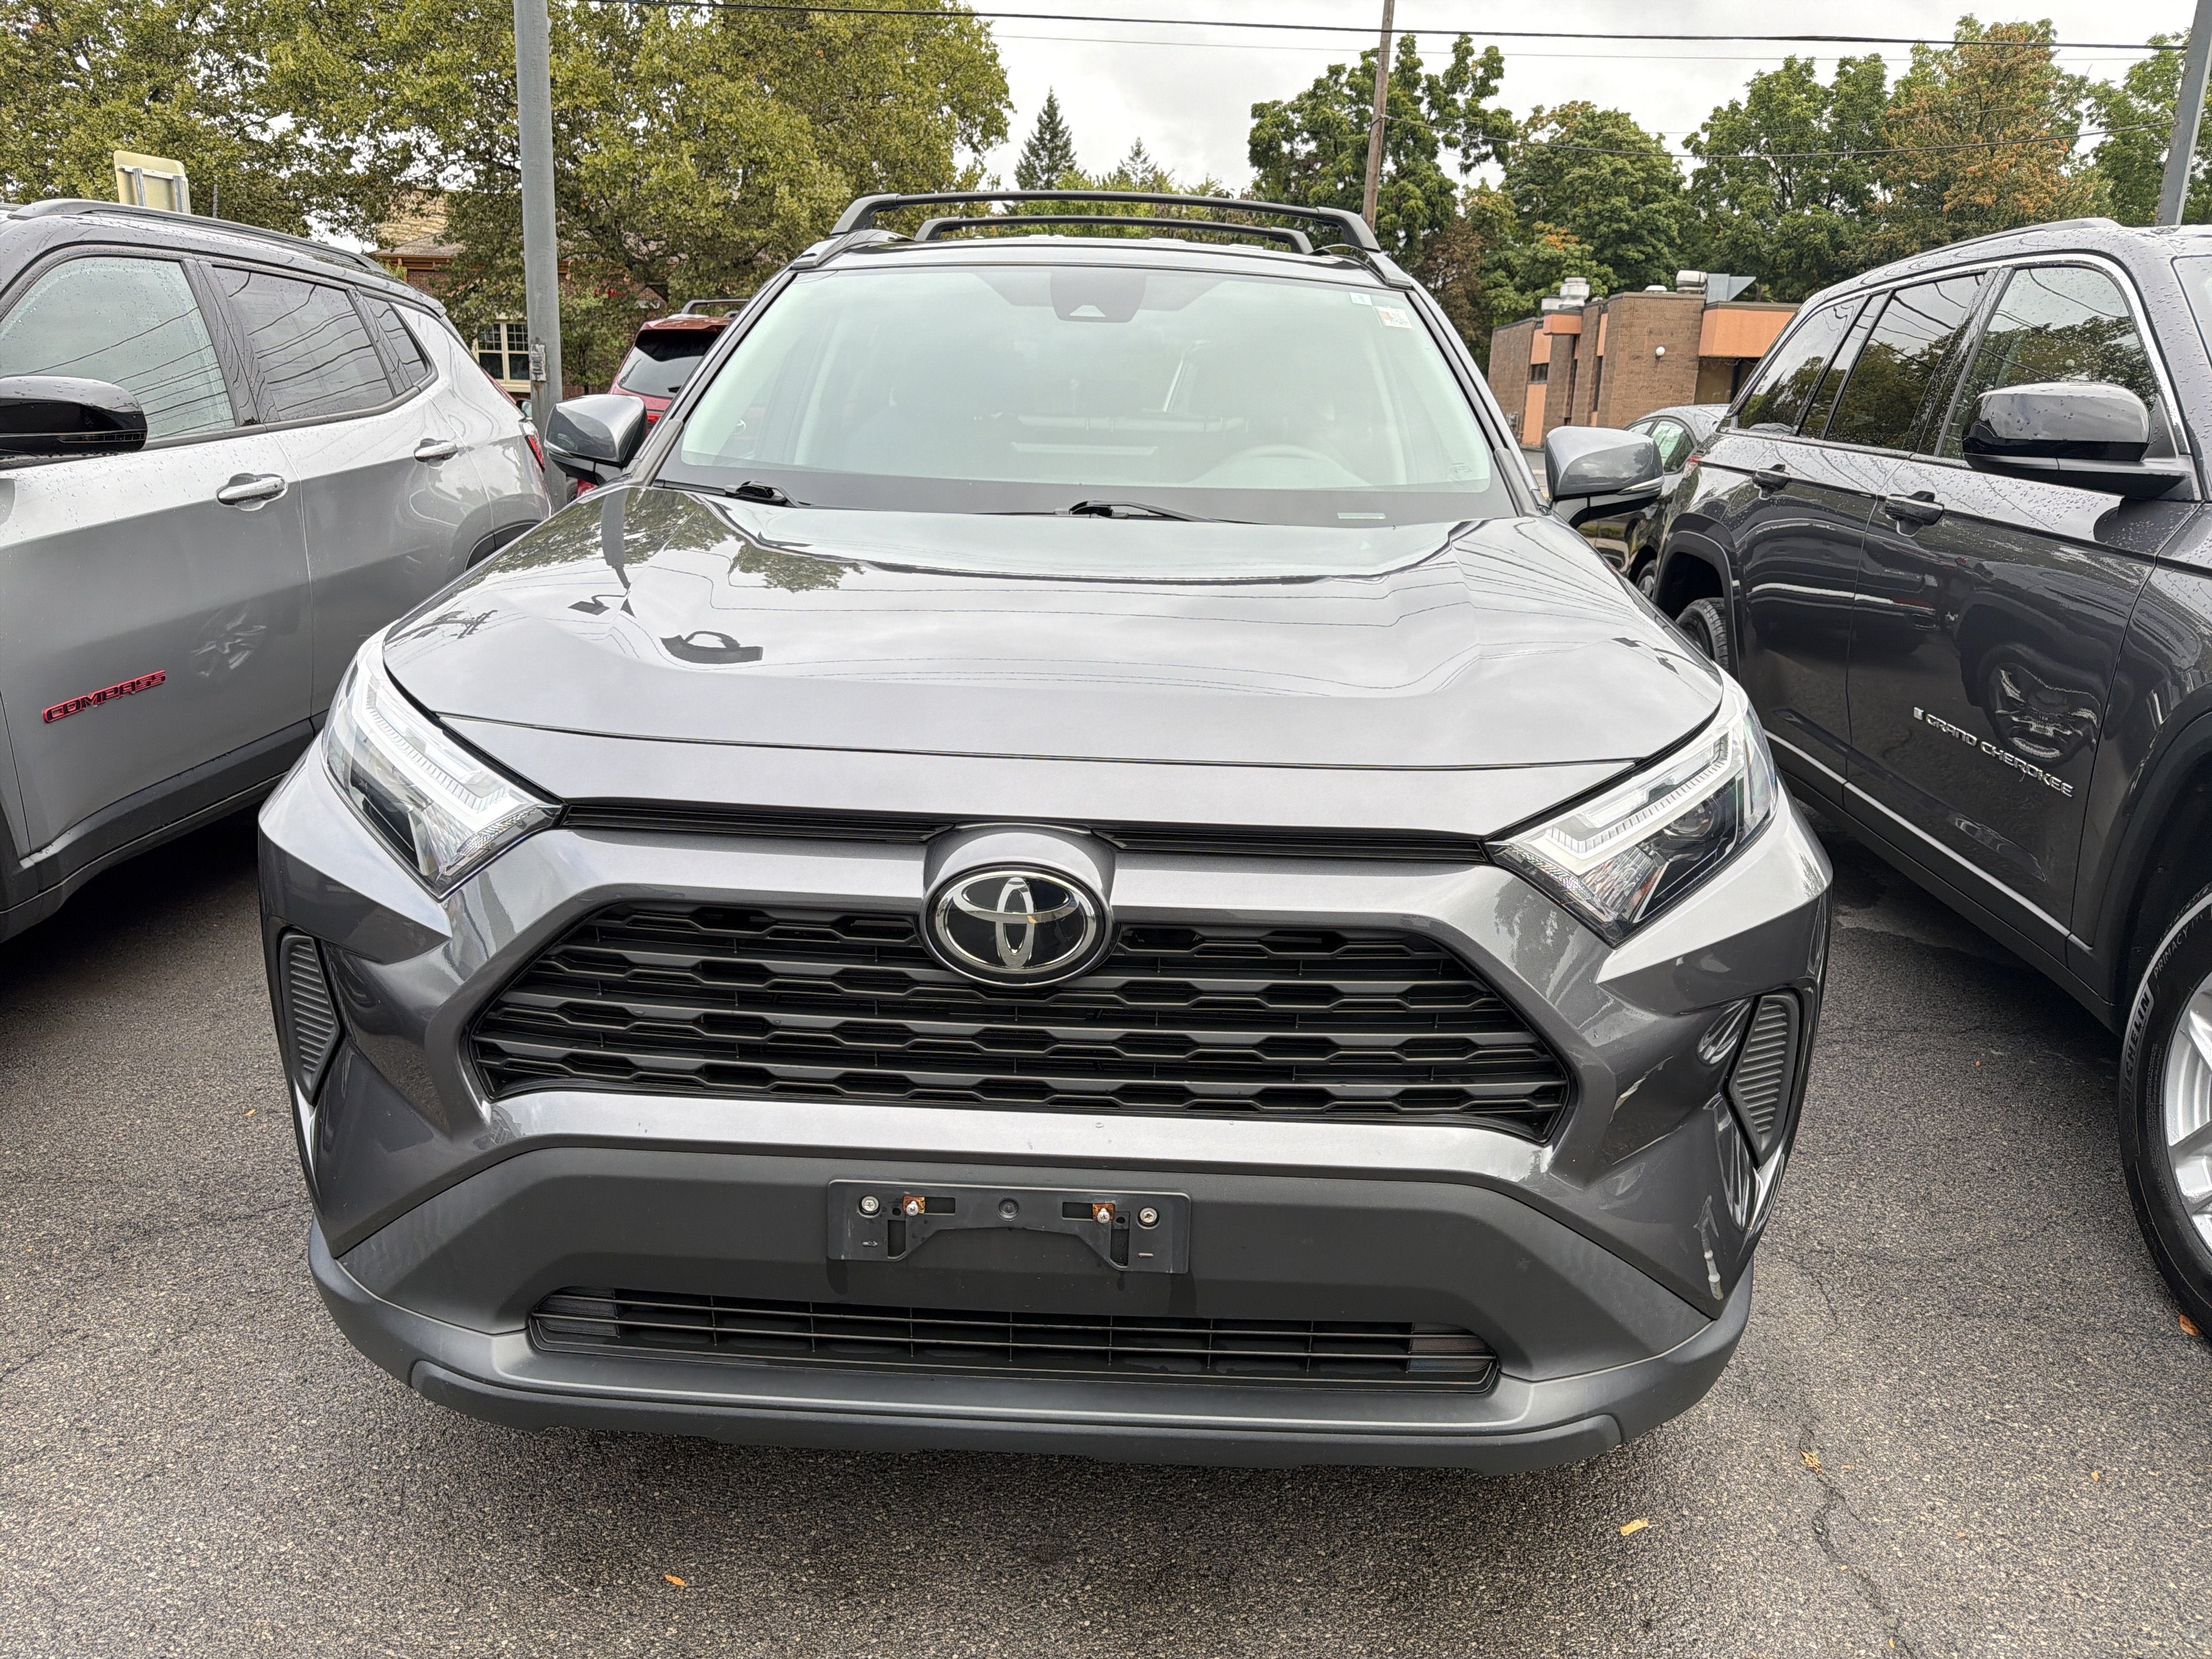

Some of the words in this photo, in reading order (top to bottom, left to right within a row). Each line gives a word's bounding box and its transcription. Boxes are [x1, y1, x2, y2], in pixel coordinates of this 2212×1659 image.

[43, 670, 166, 723] COMPASS
[1926, 713, 1978, 747] GRAND
[1980, 741, 2074, 797] CHEROKEE
[2153, 925, 2189, 979] PRIMACY
